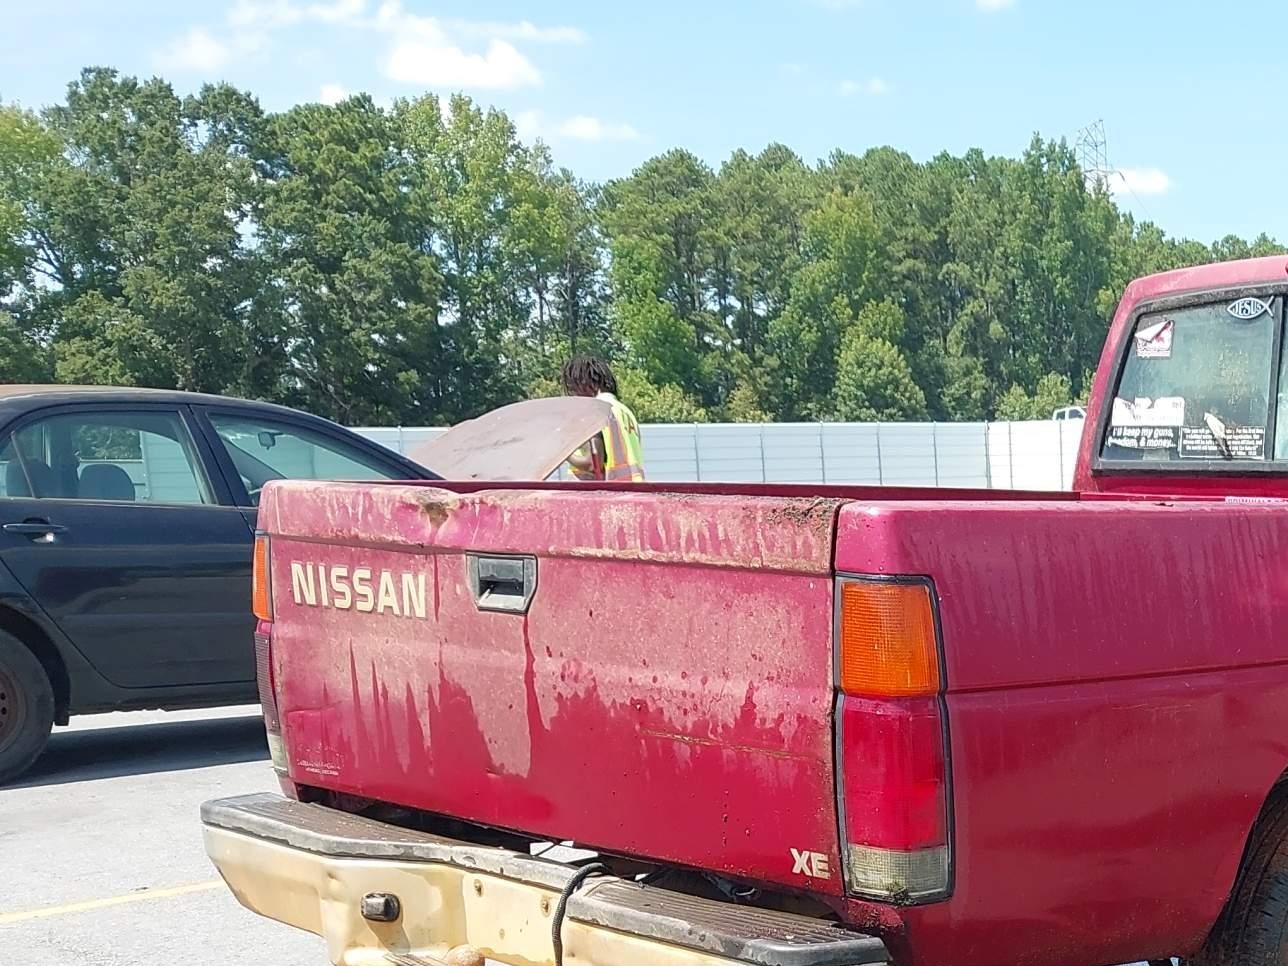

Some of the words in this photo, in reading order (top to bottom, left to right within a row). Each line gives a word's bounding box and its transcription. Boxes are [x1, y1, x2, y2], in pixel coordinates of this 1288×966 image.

[1231, 300, 1262, 316] JESUS
[1141, 428, 1154, 439] my
[290, 561, 428, 619] NISSAN
[790, 847, 831, 880] XE
